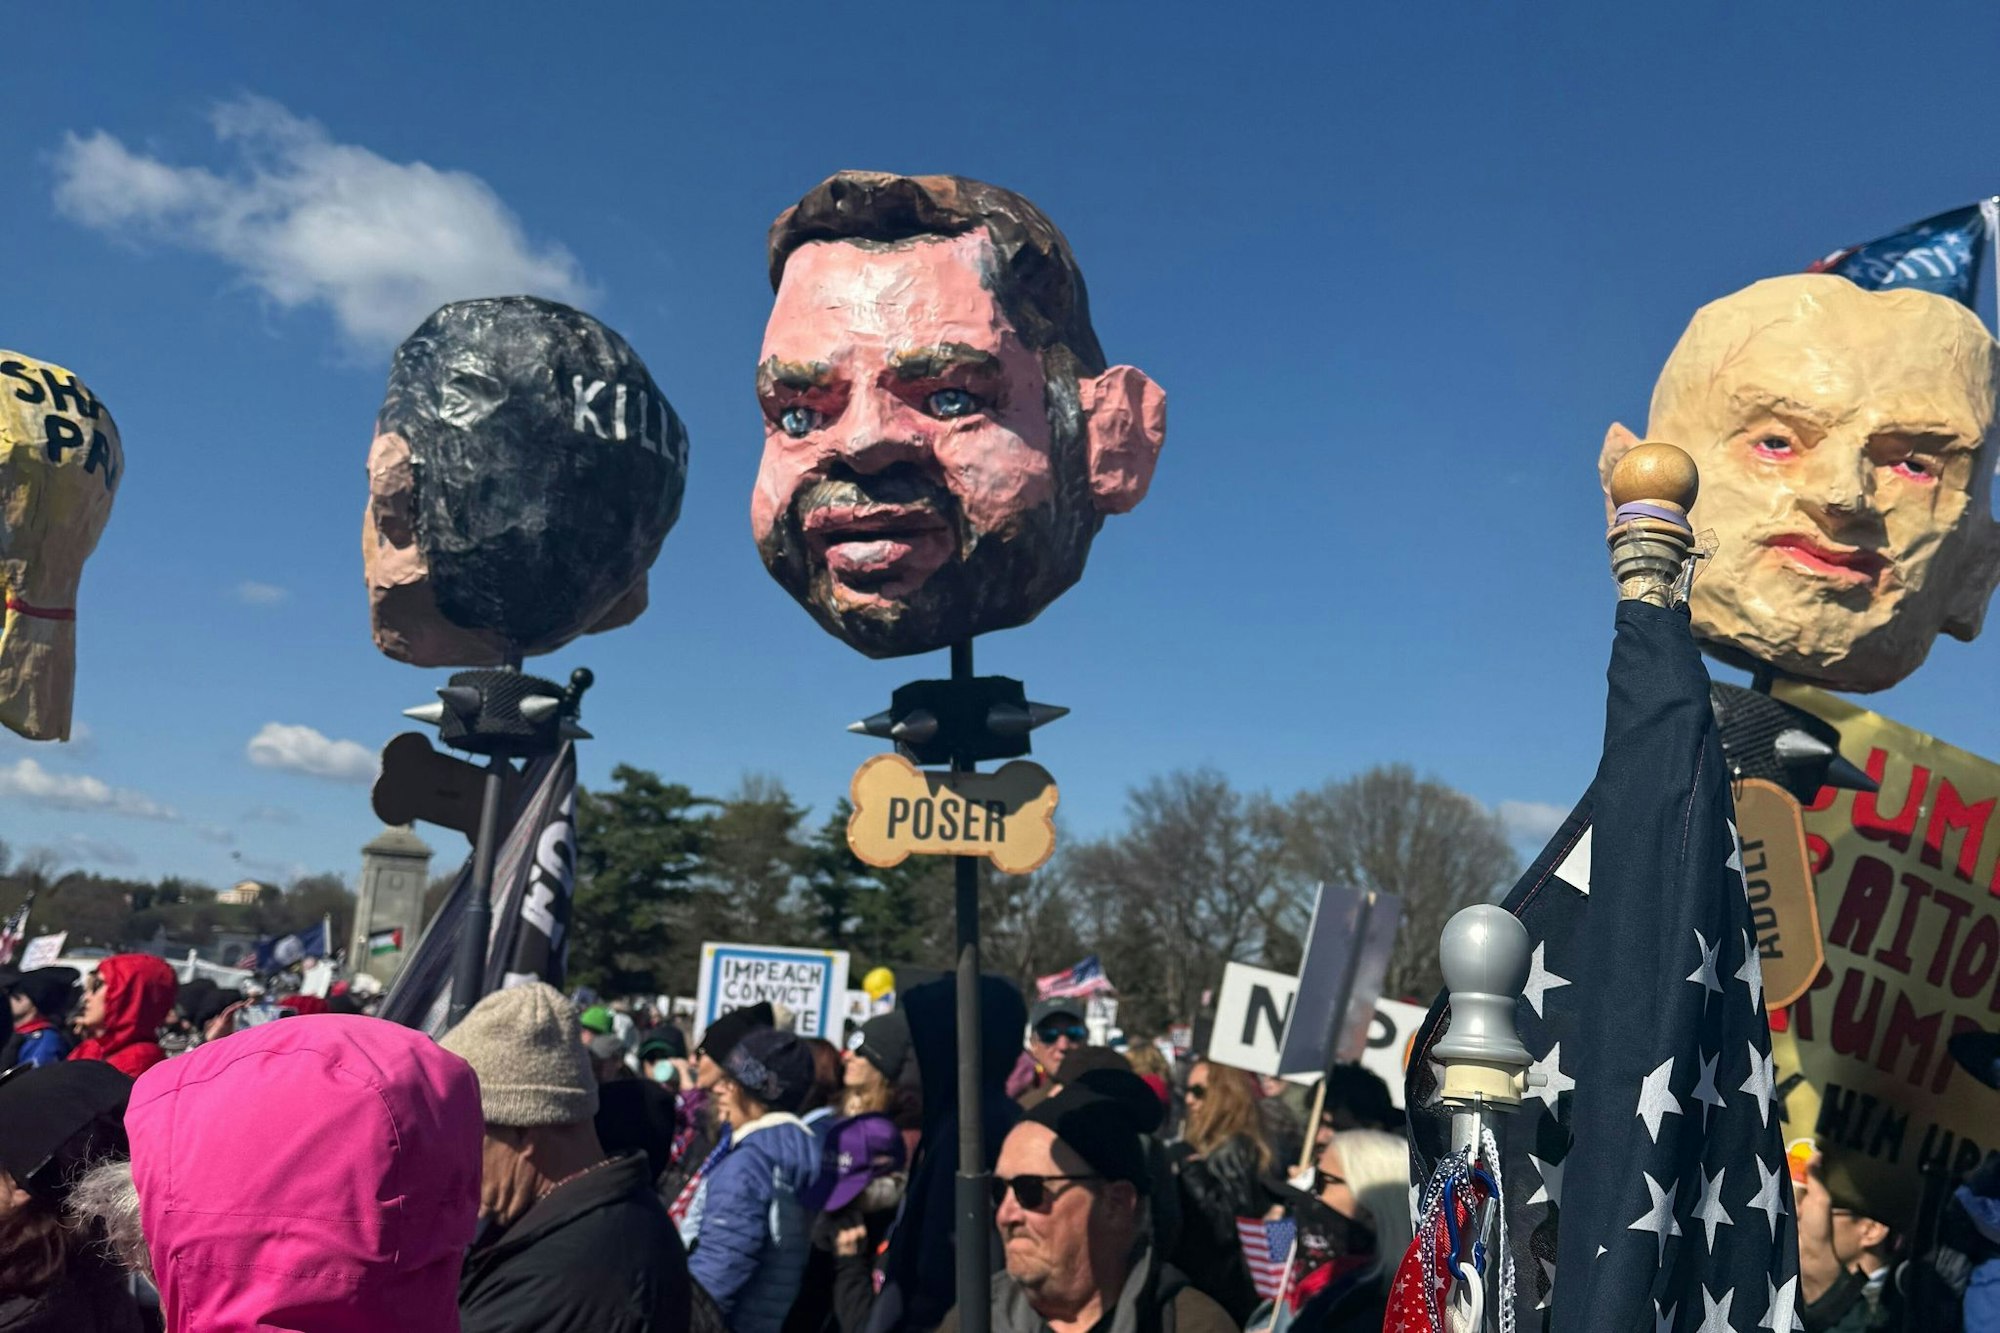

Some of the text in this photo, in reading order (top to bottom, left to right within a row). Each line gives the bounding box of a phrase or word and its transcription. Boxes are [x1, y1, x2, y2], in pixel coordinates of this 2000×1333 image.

[887, 797, 1006, 842] POSER
[724, 960, 821, 985] IMPEACH
[725, 981, 815, 1004] CONVICT
[1815, 1082, 1911, 1165] HIM
